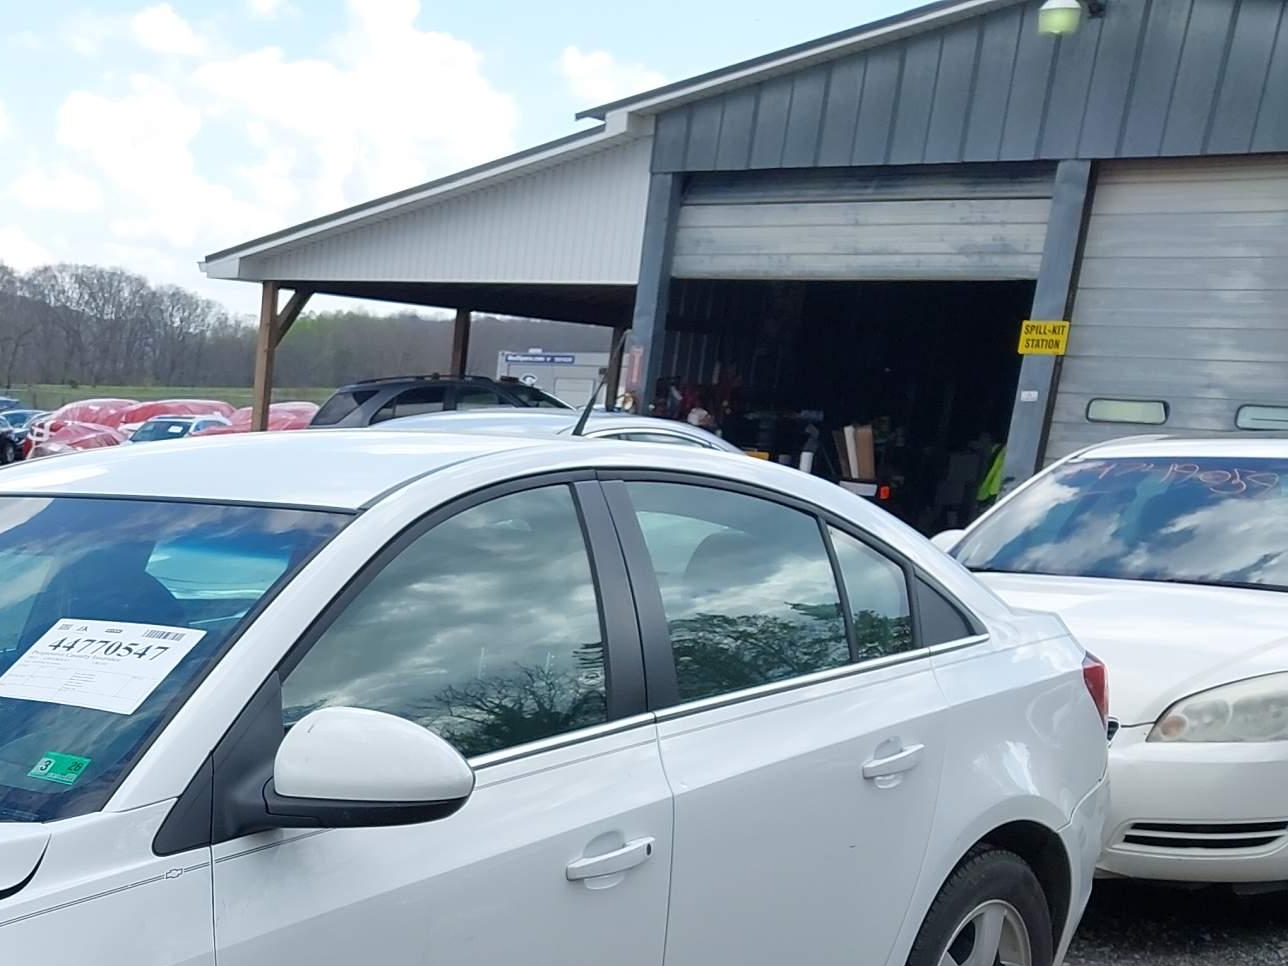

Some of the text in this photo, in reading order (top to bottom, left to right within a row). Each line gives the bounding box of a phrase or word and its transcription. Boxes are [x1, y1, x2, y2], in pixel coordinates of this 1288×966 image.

[1024, 324, 1066, 336] SPILL-KIT
[1025, 338, 1060, 350] STATION
[48, 636, 169, 661] 44770547
[39, 759, 84, 772] 3 26
